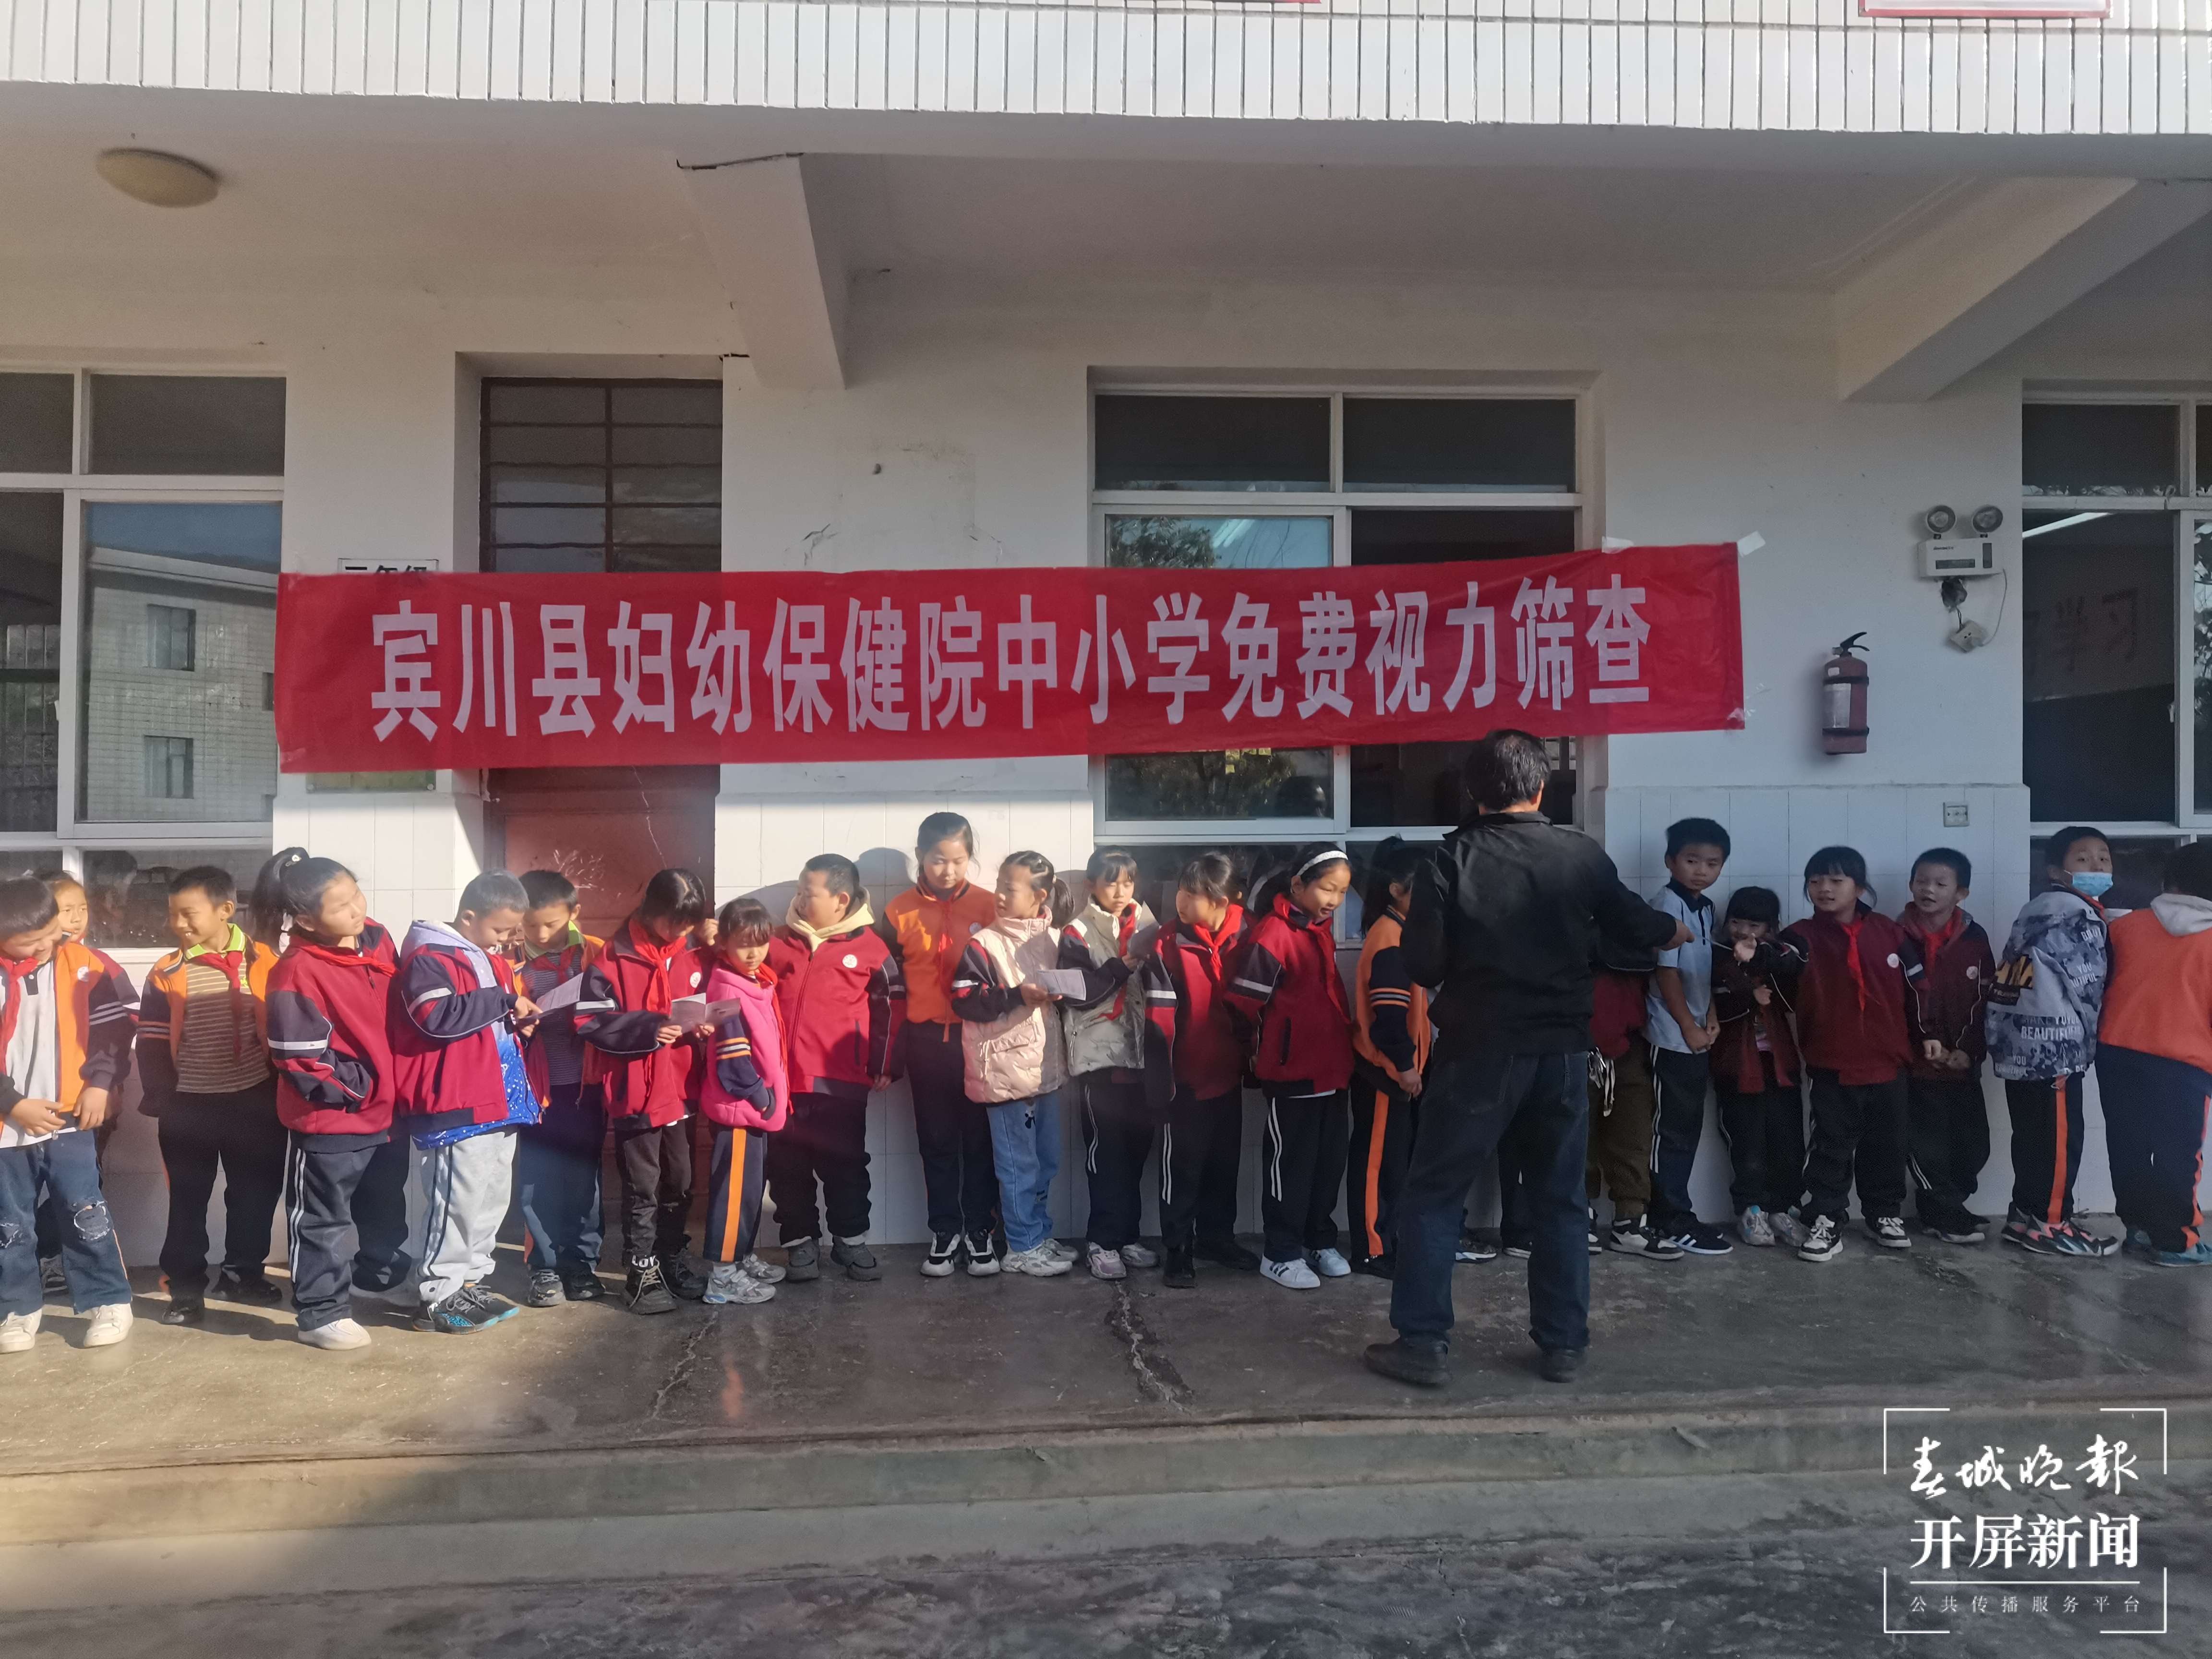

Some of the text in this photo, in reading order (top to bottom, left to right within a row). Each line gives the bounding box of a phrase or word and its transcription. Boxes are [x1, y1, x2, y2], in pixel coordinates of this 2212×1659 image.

[372, 574, 1650, 741] 宾川县妇幼保健院中小学免费视力筛查
